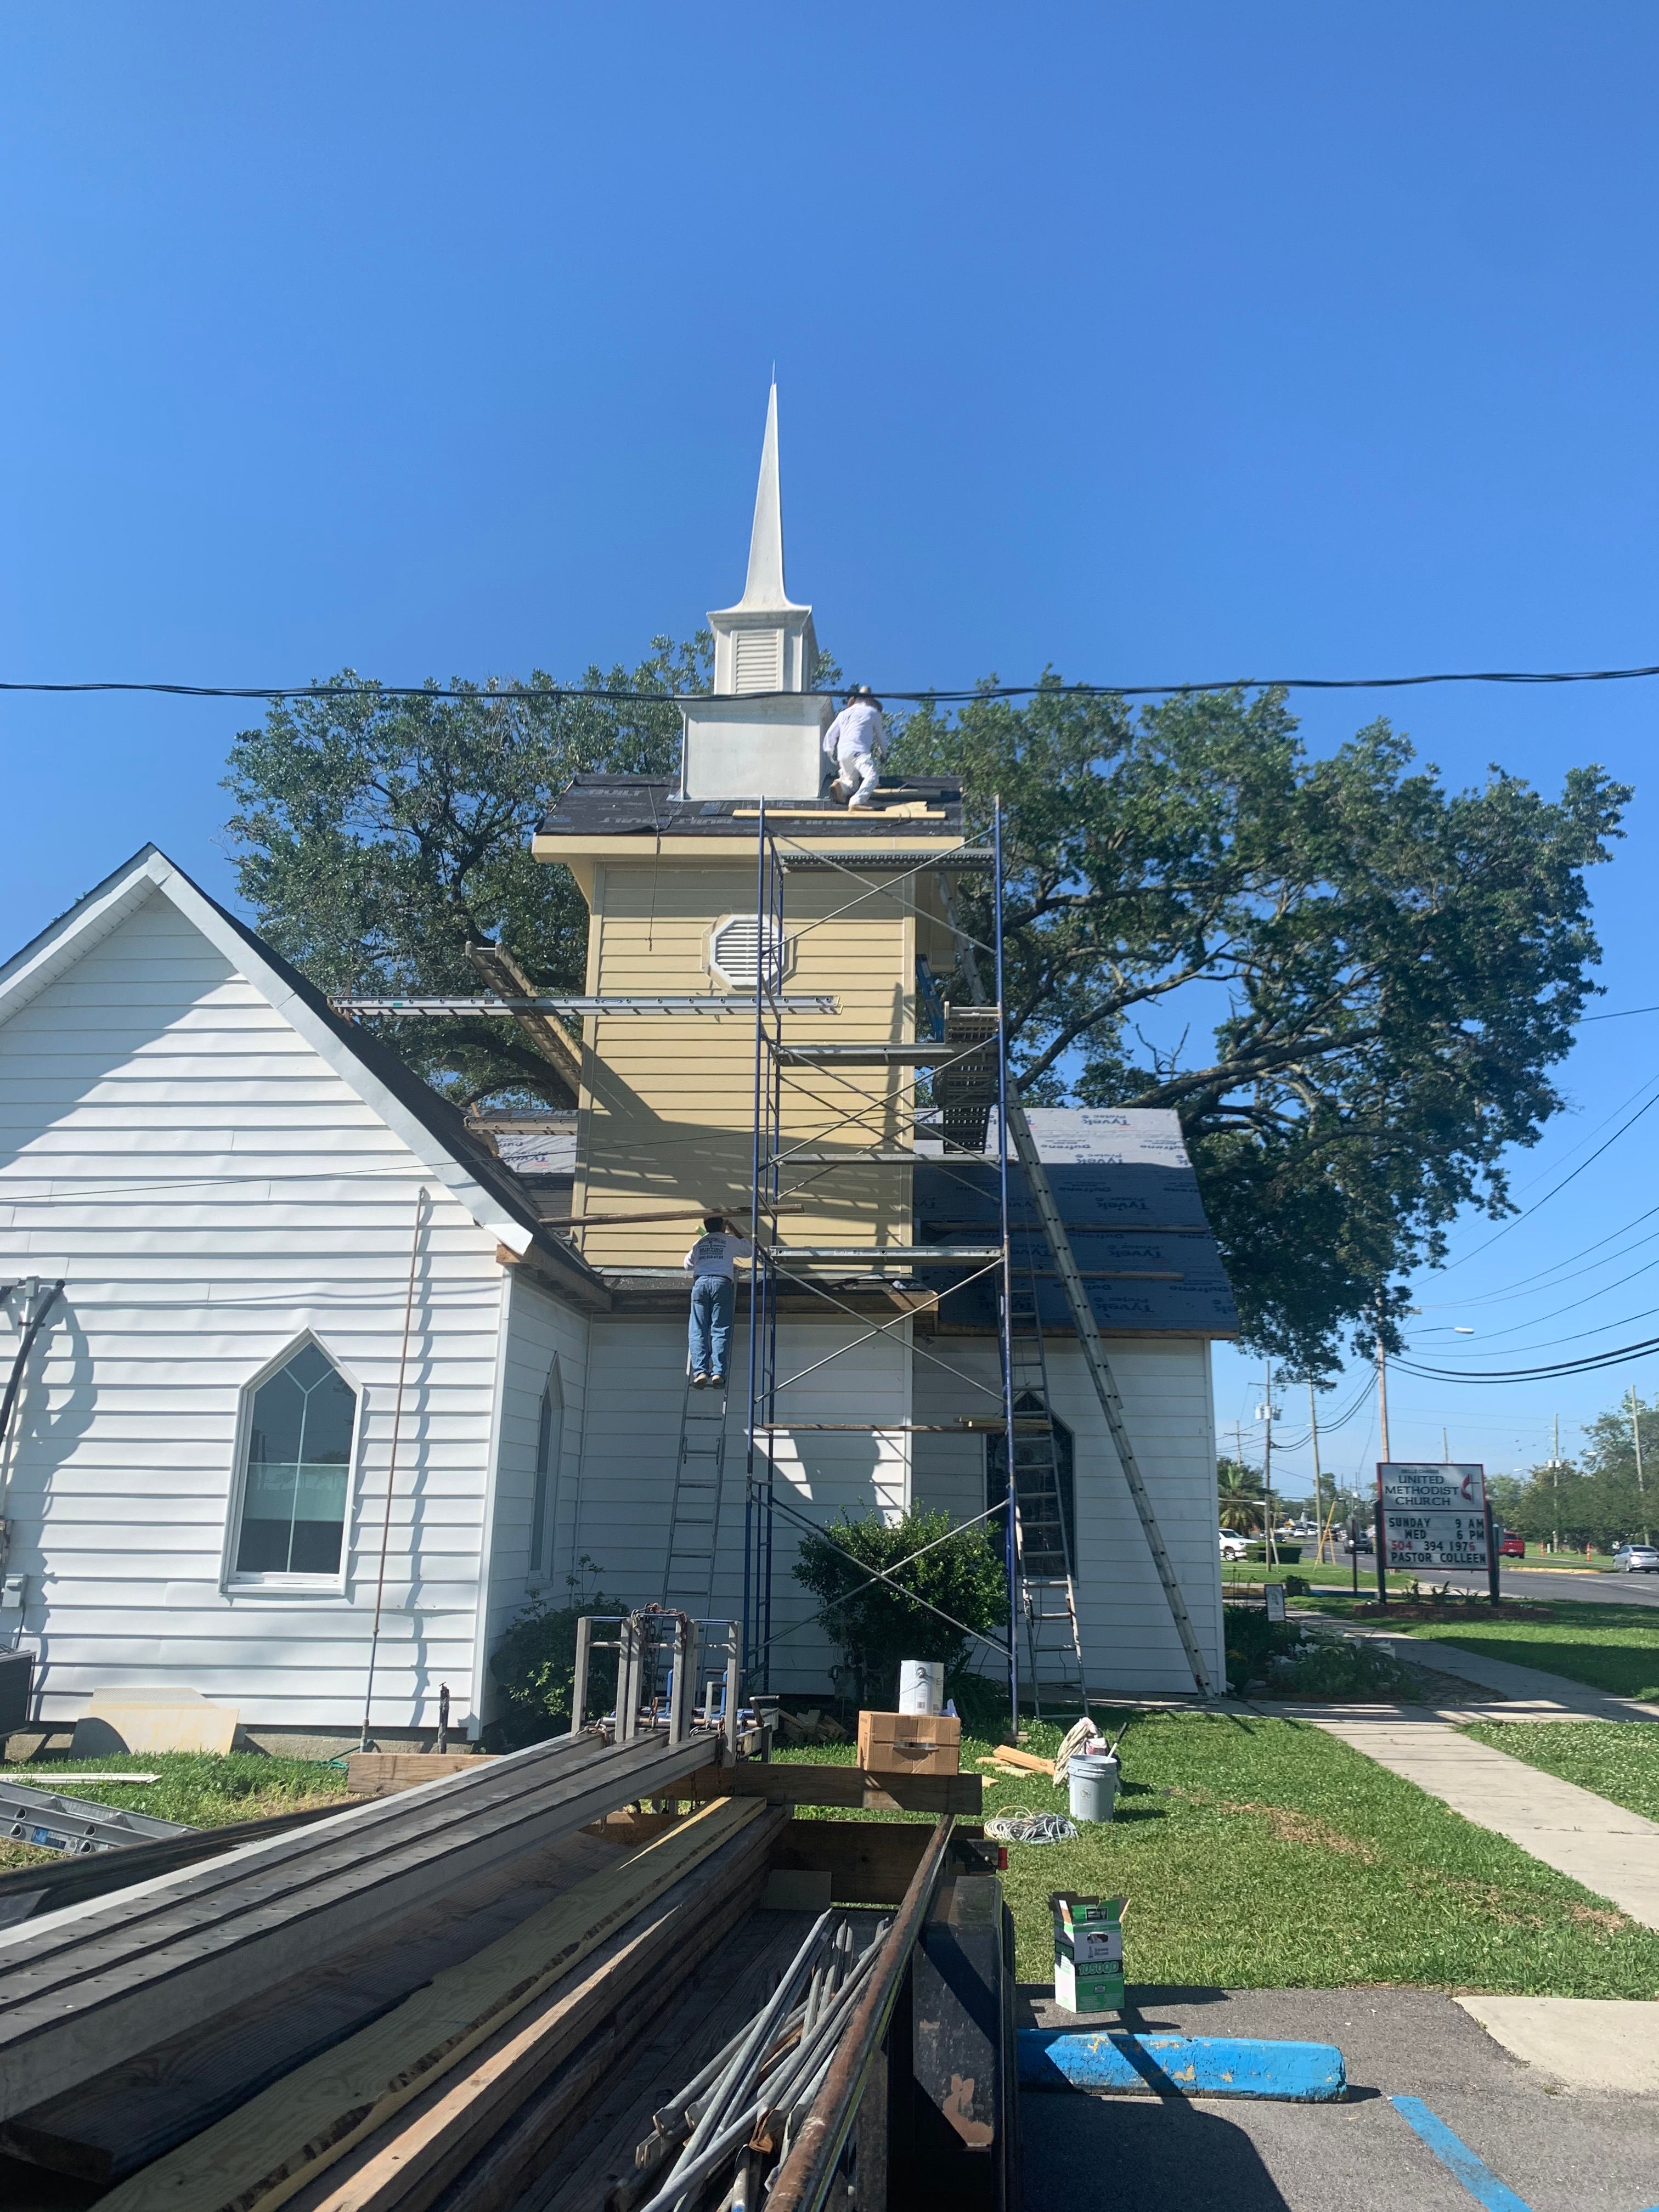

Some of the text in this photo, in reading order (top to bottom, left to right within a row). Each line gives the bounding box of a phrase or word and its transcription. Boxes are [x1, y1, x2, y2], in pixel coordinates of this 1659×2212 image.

[1097, 1201, 1151, 1210] Tyvek
[1107, 1249, 1166, 1258] Tyvek
[1095, 1303, 1155, 1313] Tyvek
[1399, 1476, 1444, 1484] UNITED
[1385, 1486, 1460, 1495] METHODIST
[1395, 1497, 1451, 1506] CHURCH
[1389, 1517, 1485, 1528] SUNDAY 9 AM
[1404, 1529, 1485, 1540] WED 6 PM
[1391, 1541, 1475, 1551] 504 394 1976
[1391, 1552, 1486, 1563] PASTOR COLLEEN
[1078, 1961, 1119, 1976] 1050QD
